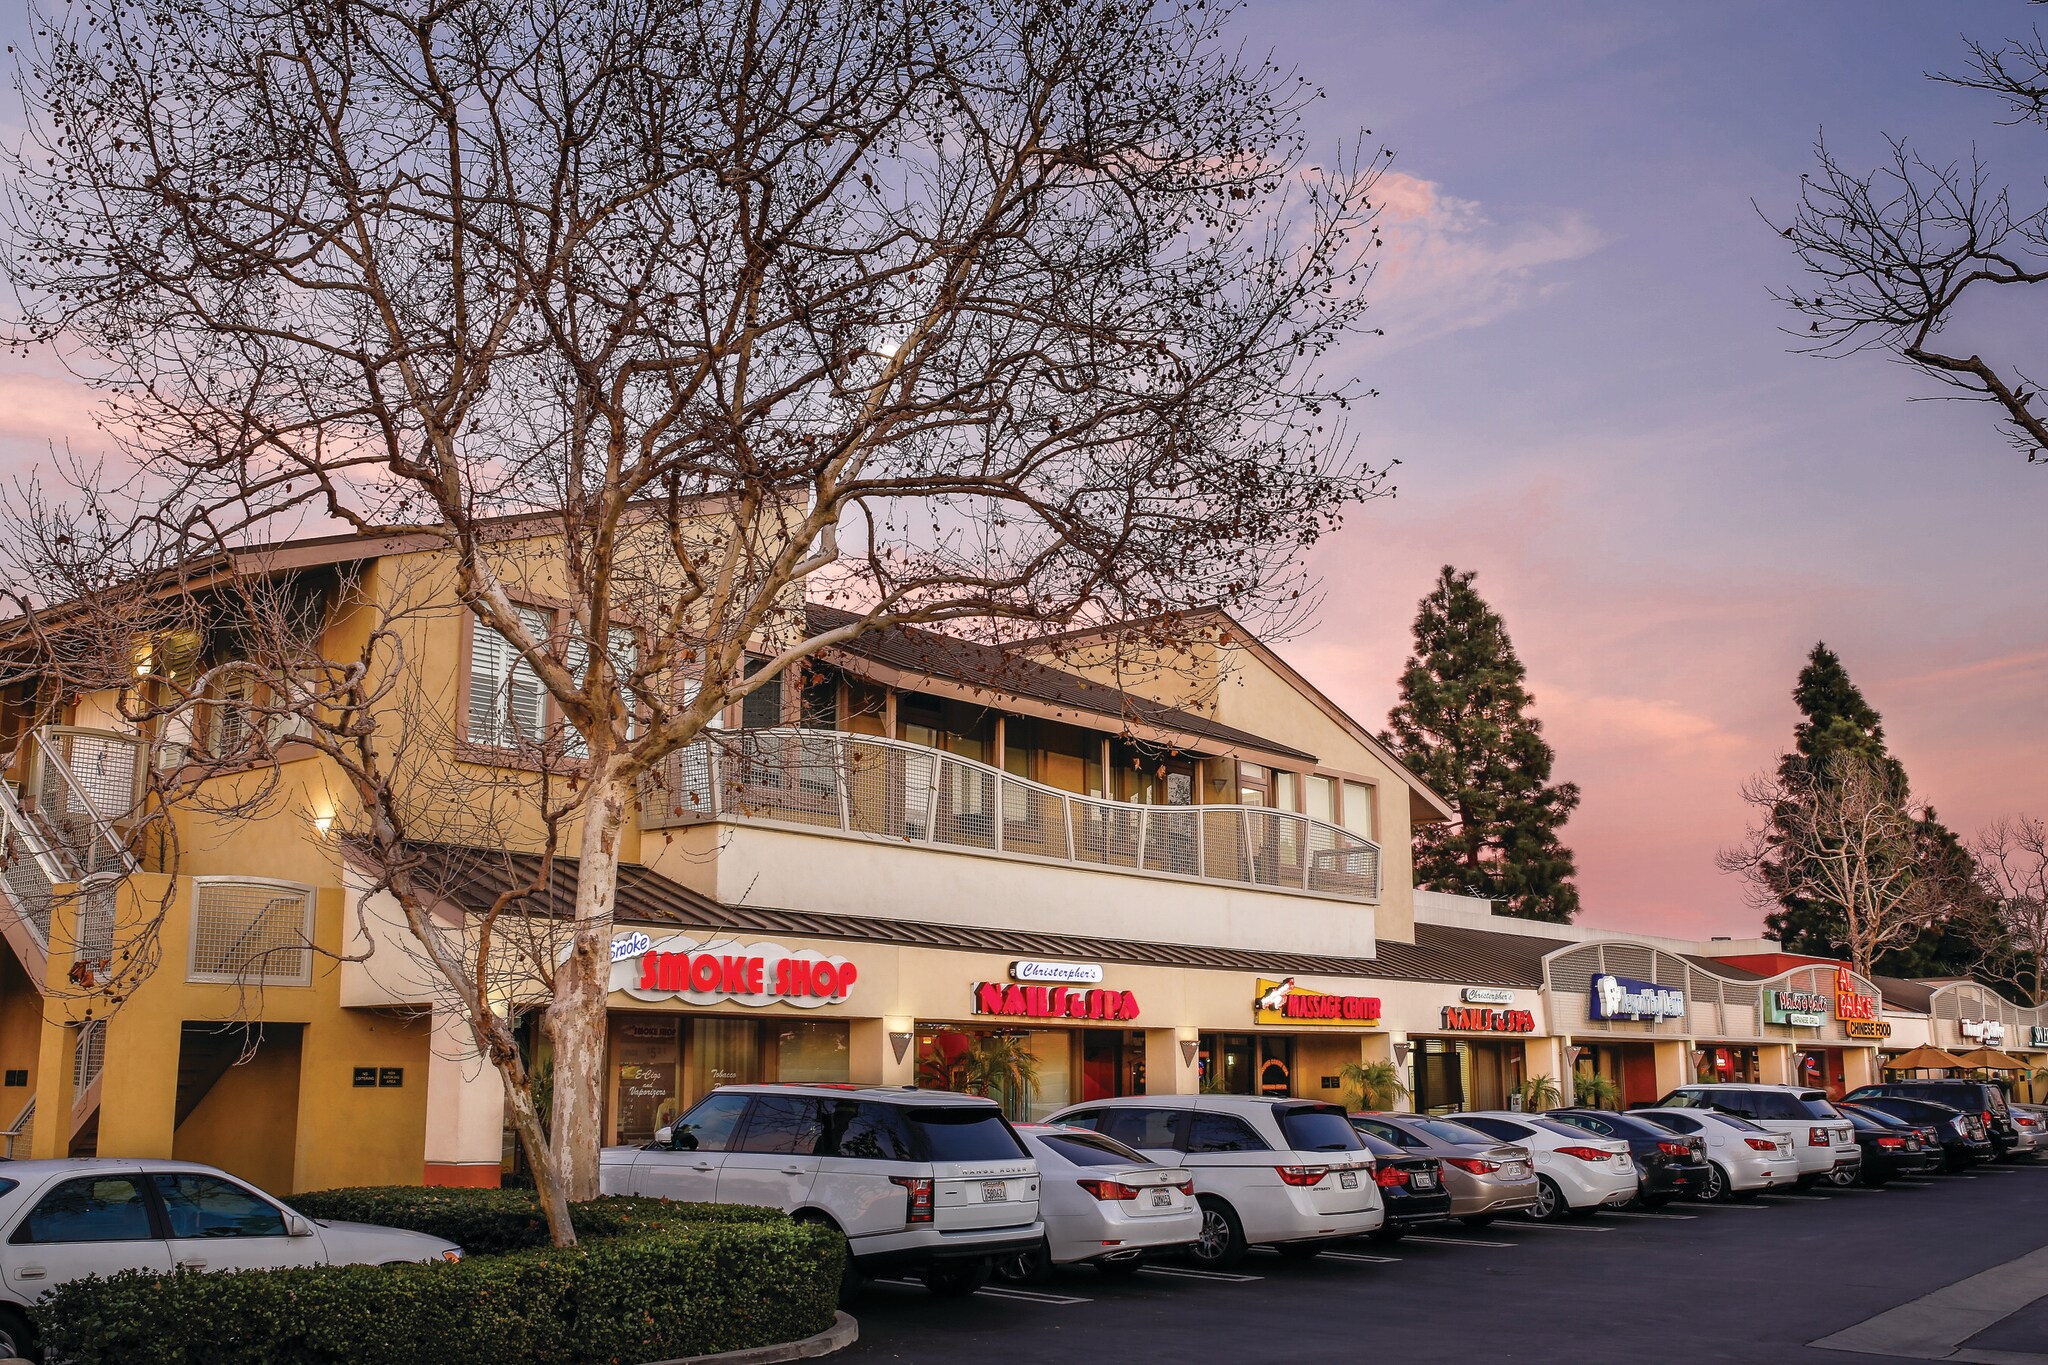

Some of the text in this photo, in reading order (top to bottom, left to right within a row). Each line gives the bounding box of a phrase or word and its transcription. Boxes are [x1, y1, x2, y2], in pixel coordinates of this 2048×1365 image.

[640, 951, 857, 997] SMOKE SHOP
[1022, 962, 1096, 980] Christerpher's
[977, 981, 1141, 1020] NAILS & SPA
[1287, 994, 1382, 1019] MASSAGE CENTER
[1446, 1006, 1493, 1030] NAILS
[1507, 1009, 1535, 1032] SPA
[1850, 1022, 1891, 1036] CHINESE FOOD
[635, 1069, 661, 1080] E-Cigs
[711, 1068, 737, 1079] Tobacco
[629, 1086, 666, 1099] Vaporizers
